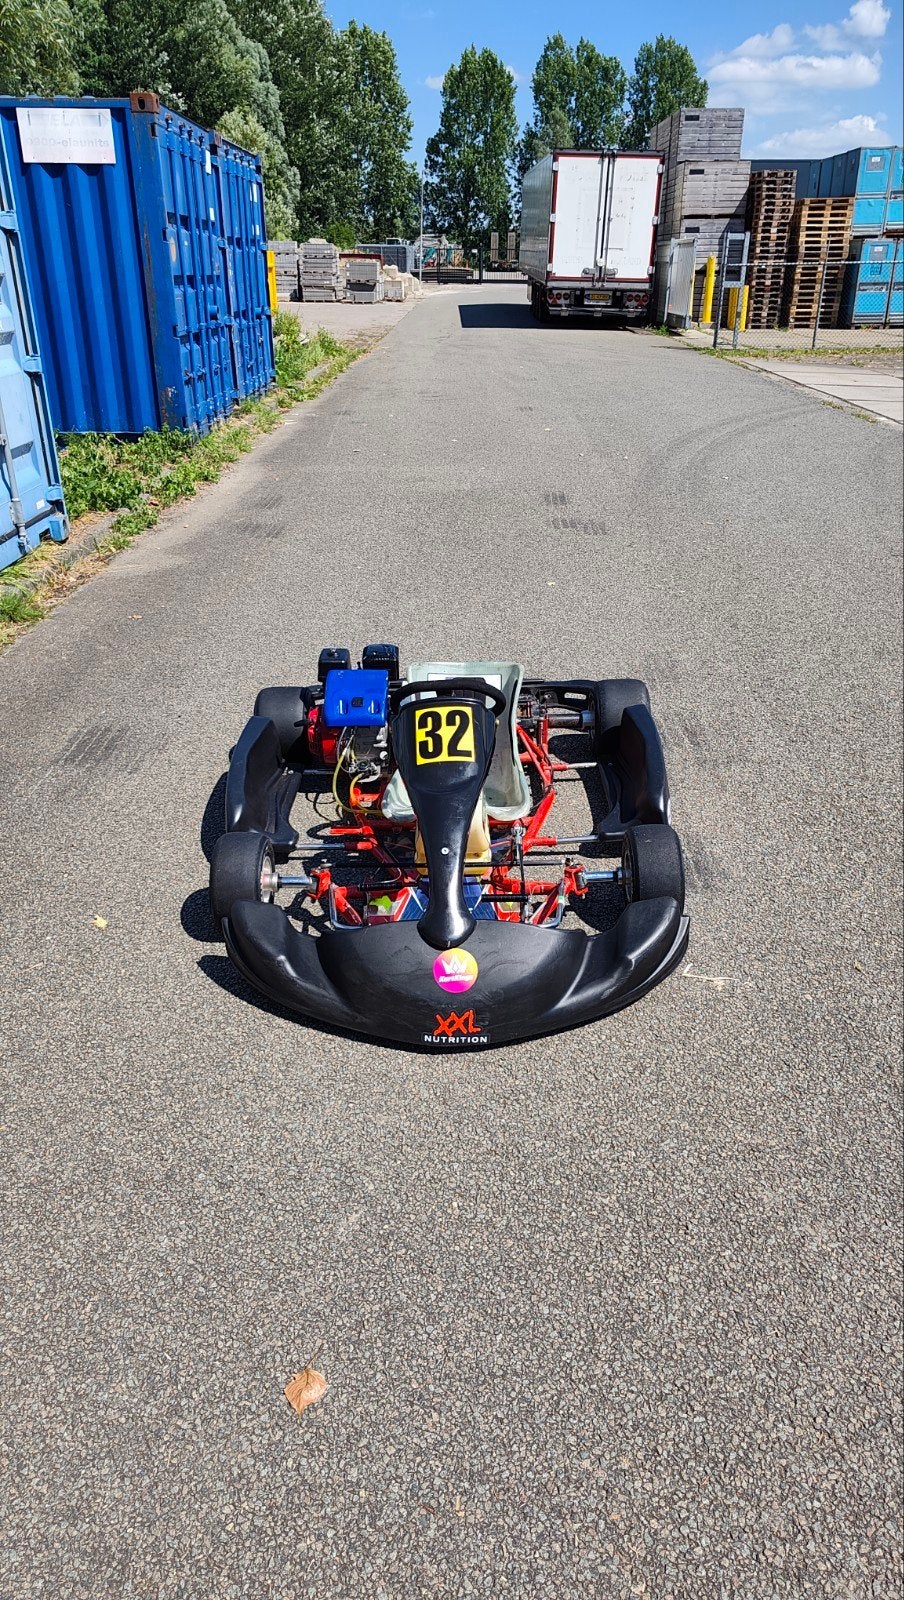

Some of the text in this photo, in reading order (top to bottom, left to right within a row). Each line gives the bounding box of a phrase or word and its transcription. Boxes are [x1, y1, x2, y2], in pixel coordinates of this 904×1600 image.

[418, 709, 473, 760] 32
[433, 1009, 481, 1036] XXL
[424, 1035, 488, 1043] NUTRITION
